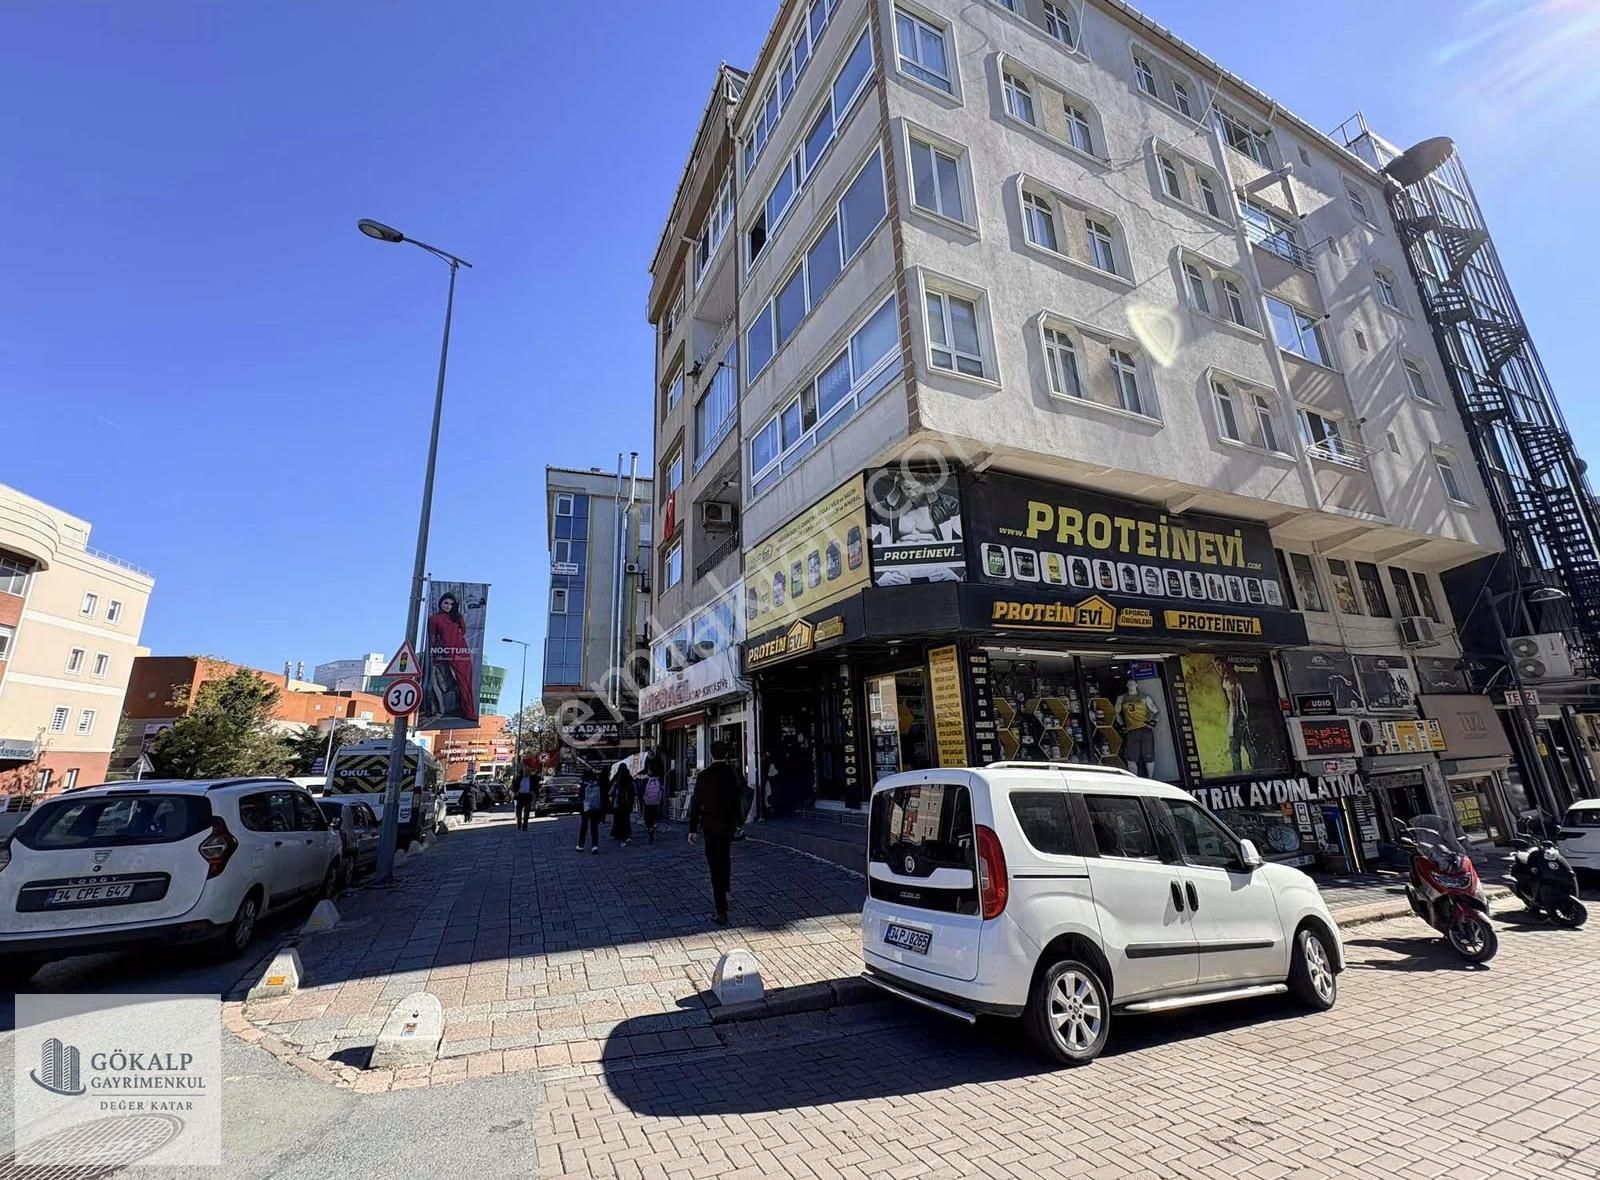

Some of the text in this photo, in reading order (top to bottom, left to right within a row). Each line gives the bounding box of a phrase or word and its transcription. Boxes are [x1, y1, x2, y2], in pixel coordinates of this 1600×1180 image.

[1026, 500, 1245, 568] PROTEİNEVİ
[883, 547, 956, 566] PROTEİNEVİ
[992, 601, 1100, 625] PROTEİN EVİ
[1178, 613, 1254, 634] PROTEİNEVİ
[748, 635, 787, 665] PROTEİN
[390, 689, 416, 707] 30
[1128, 703, 1137, 713] 3
[578, 724, 618, 733] ADANA
[340, 768, 371, 777] OKUL
[845, 744, 857, 787] SHOP
[1250, 773, 1367, 808] AYDINLATMA
[55, 885, 131, 901] 34 CPE 647
